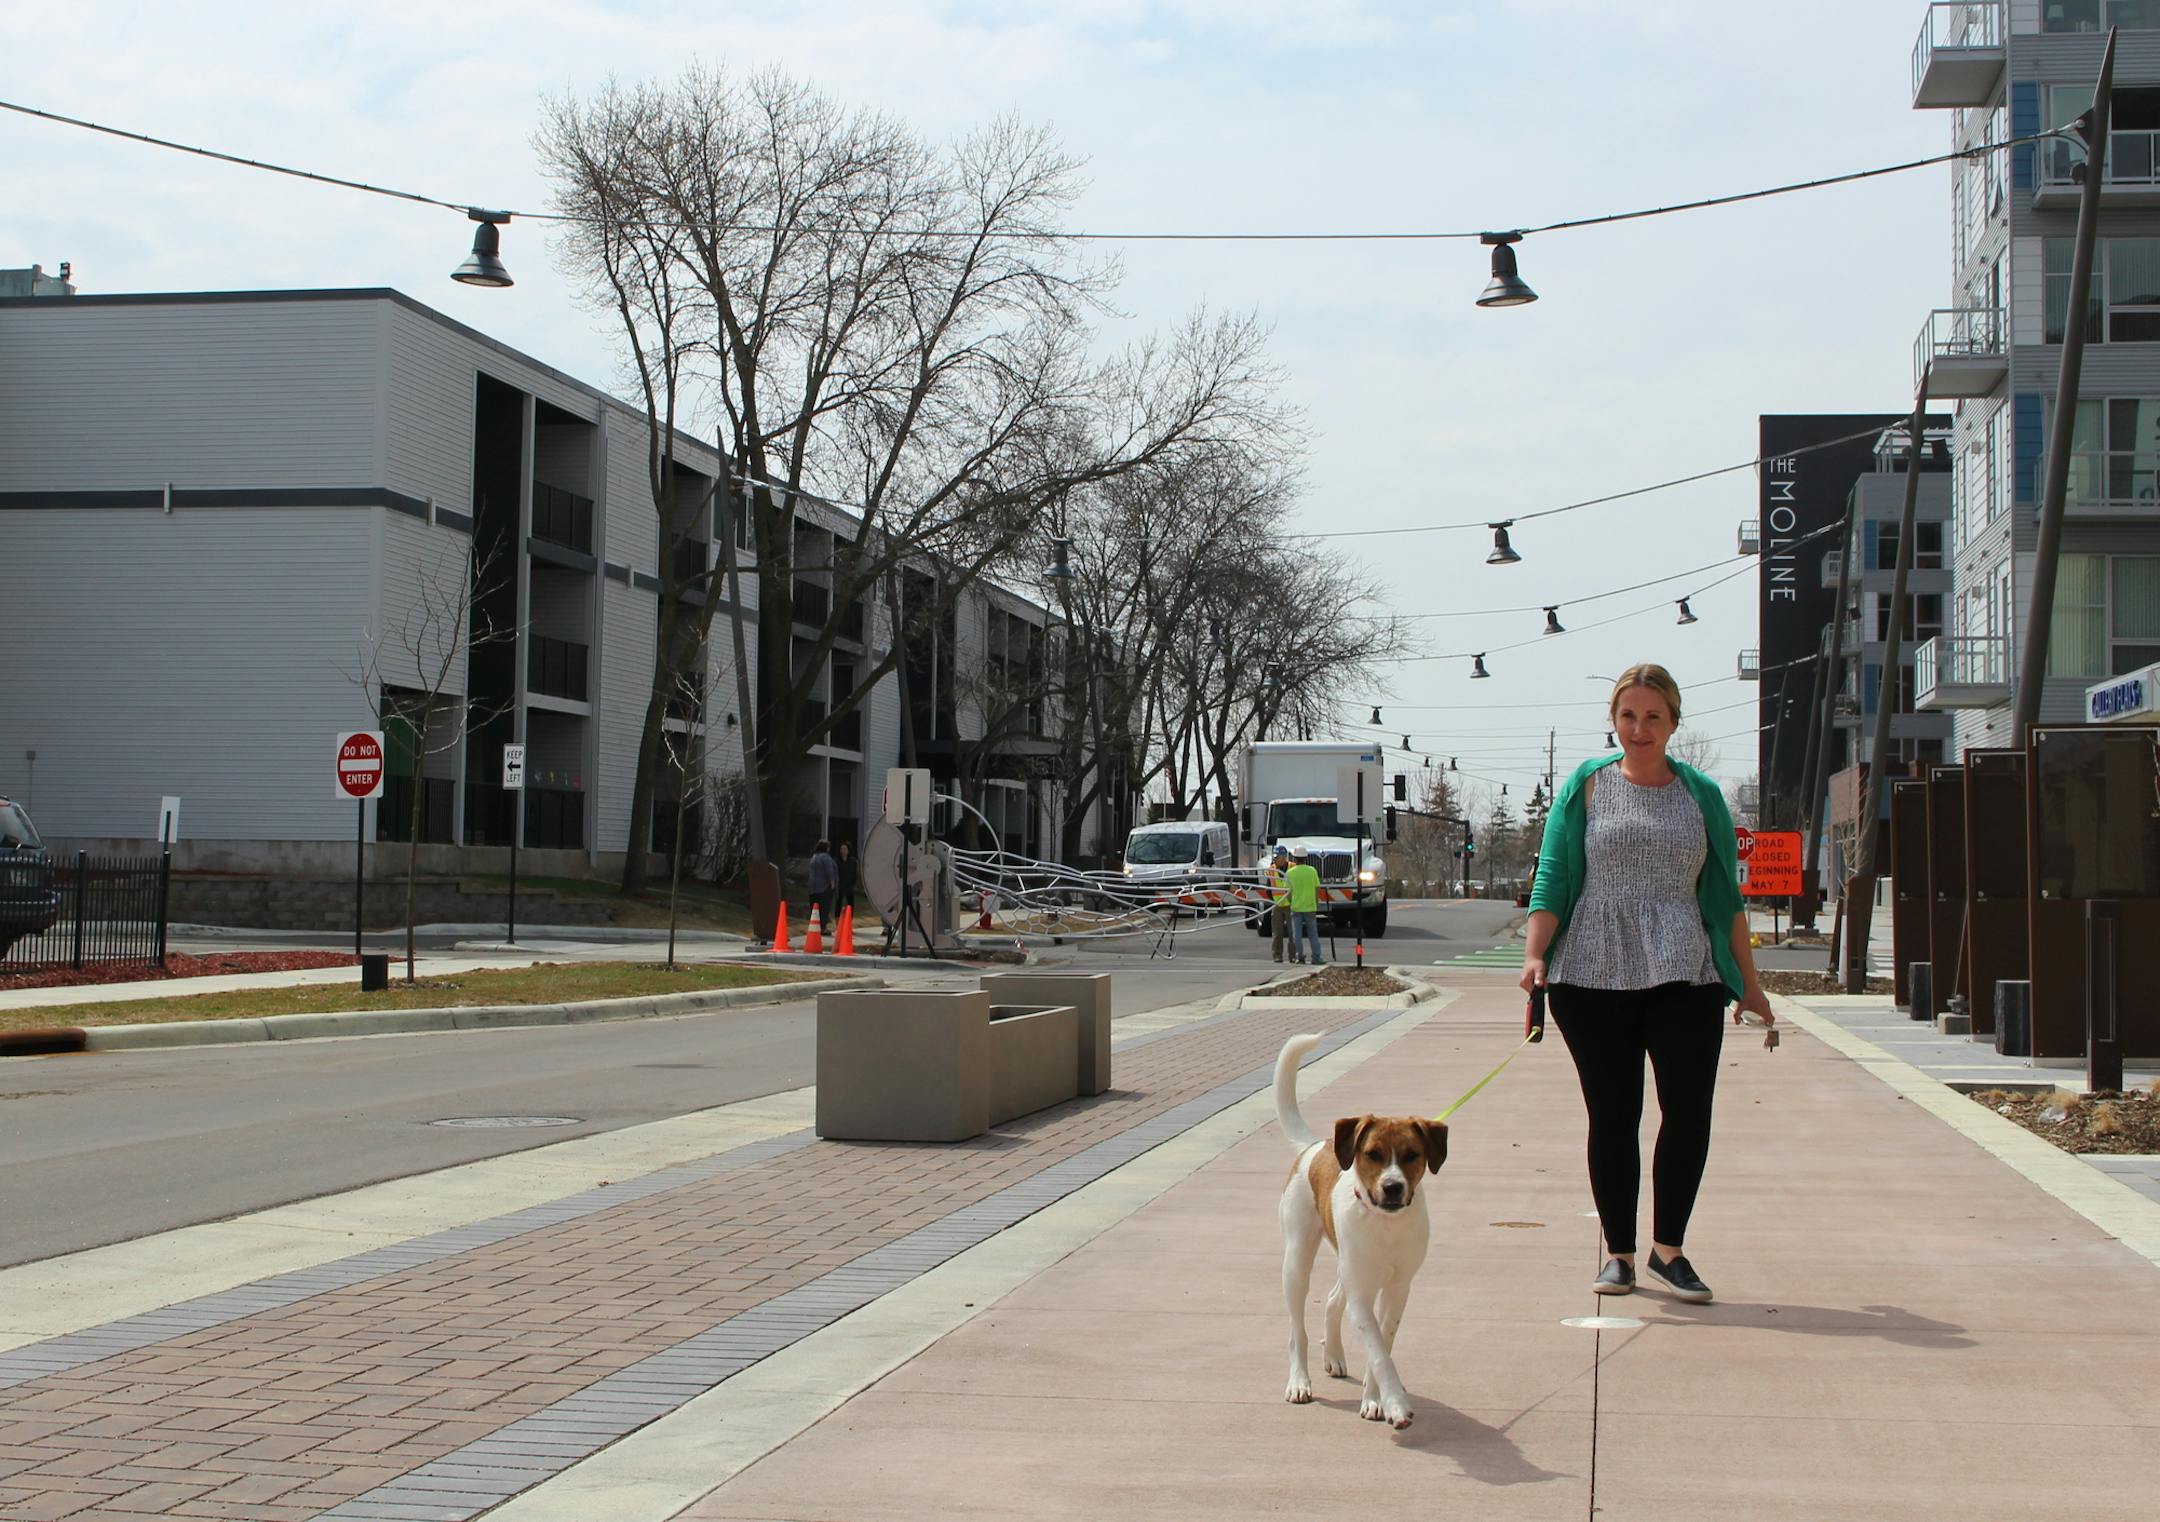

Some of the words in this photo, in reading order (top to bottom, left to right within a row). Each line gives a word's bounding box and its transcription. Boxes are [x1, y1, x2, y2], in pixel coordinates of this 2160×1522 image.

[1770, 458, 1797, 474] THE
[1769, 481, 1796, 602] MOLINE
[343, 745, 356, 757] DO
[360, 744, 377, 756] NOT
[506, 749, 523, 759] KEEP
[346, 773, 374, 785] ENTER
[506, 773, 522, 783] LEFT
[1737, 836, 1754, 850] OP
[1749, 865, 1799, 876] EGINNING
[1751, 880, 1774, 890] MAY
[1782, 879, 1789, 890] 7
